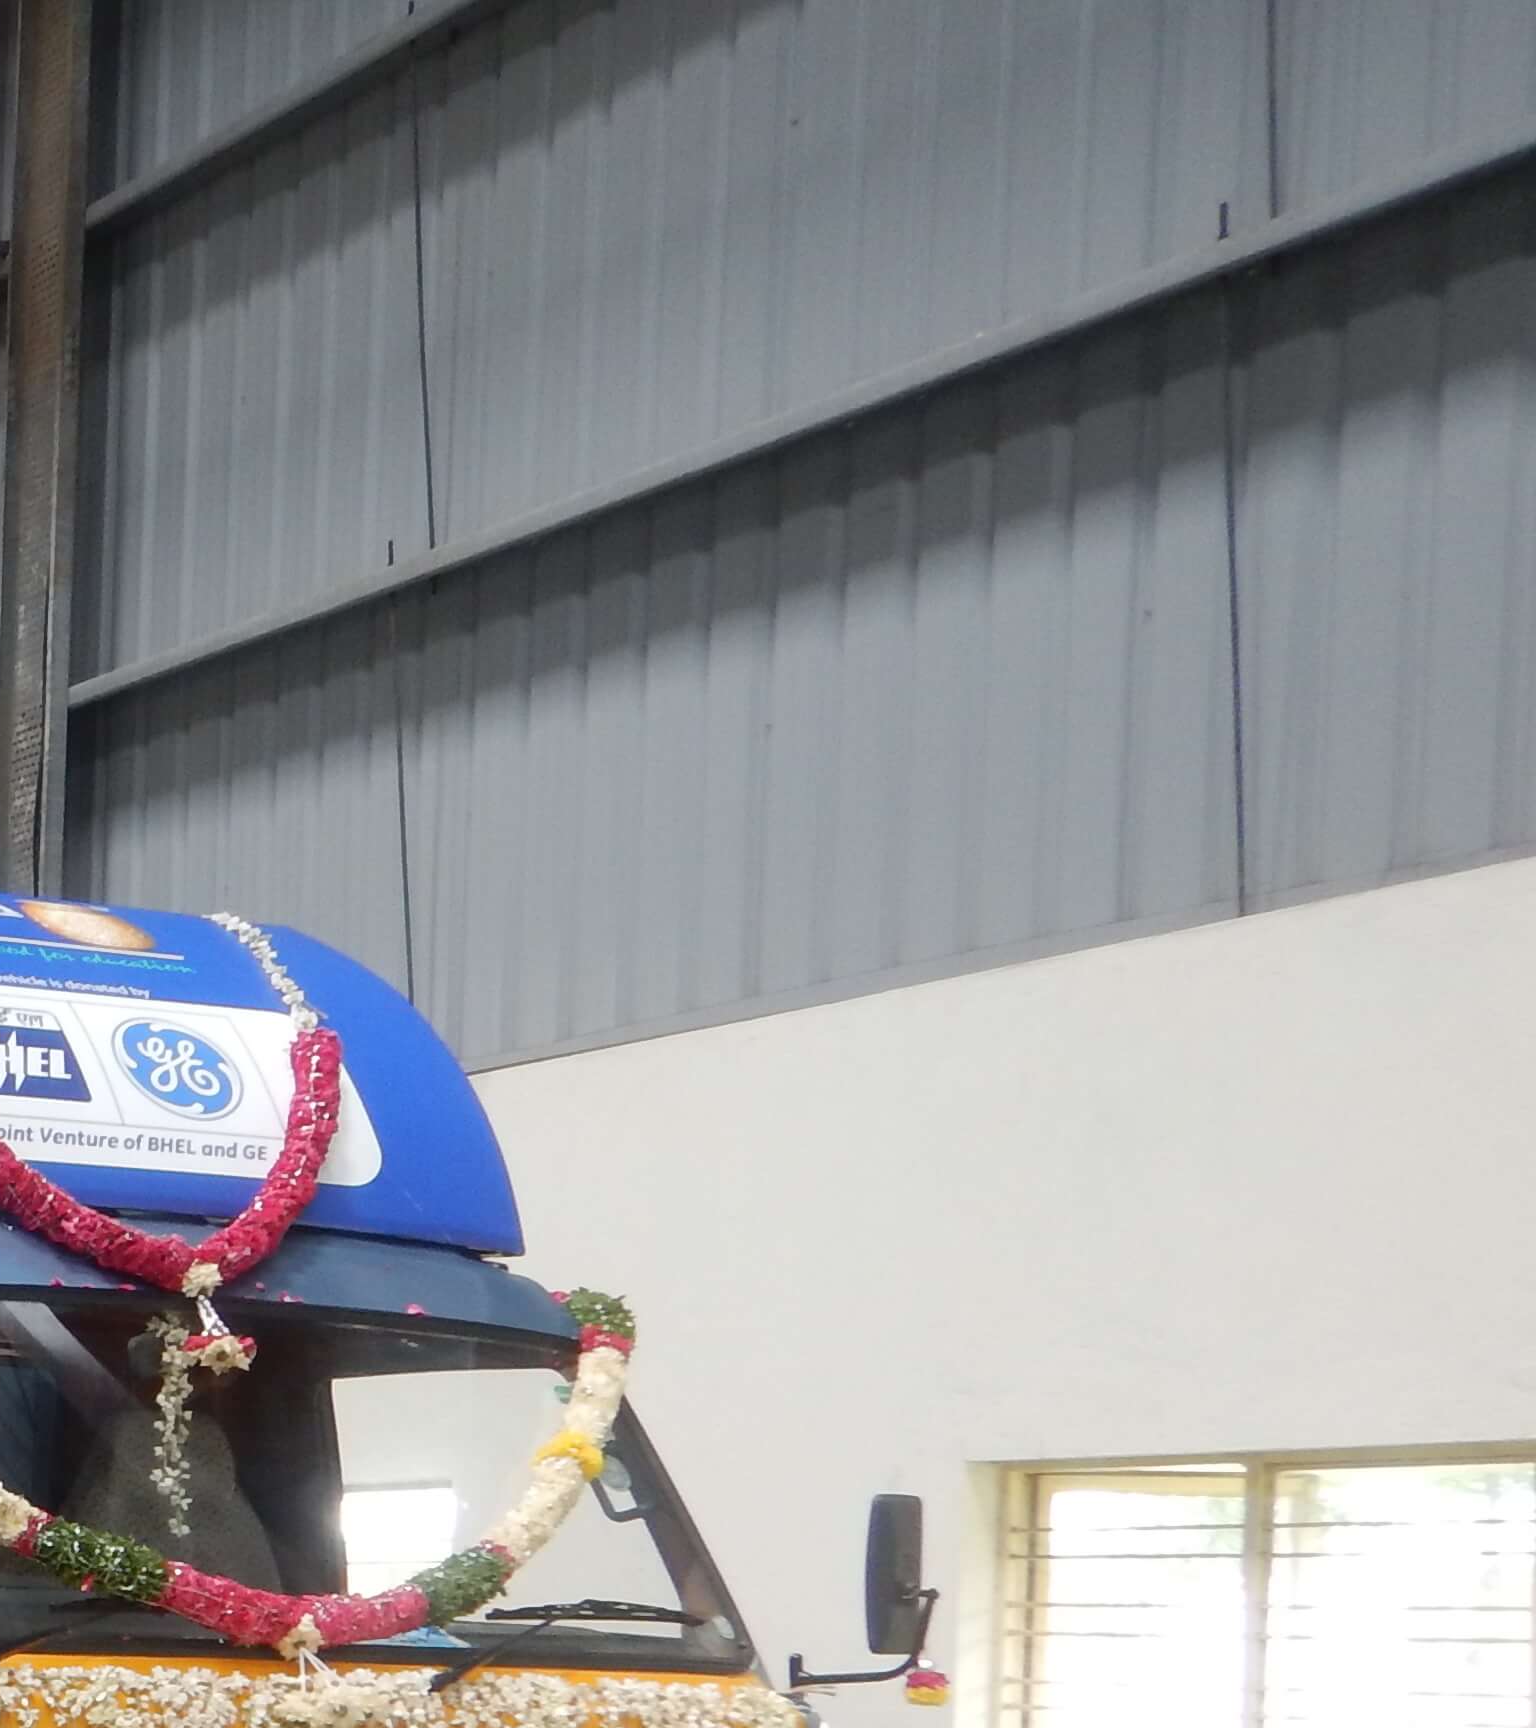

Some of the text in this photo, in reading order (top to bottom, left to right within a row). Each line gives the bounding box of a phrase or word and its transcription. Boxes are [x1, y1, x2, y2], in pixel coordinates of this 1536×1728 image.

[39, 1126, 120, 1149] Venture
[123, 1133, 144, 1150] of
[147, 1136, 196, 1155] BHEL
[201, 1141, 238, 1159] and
[242, 1144, 269, 1161] GE
